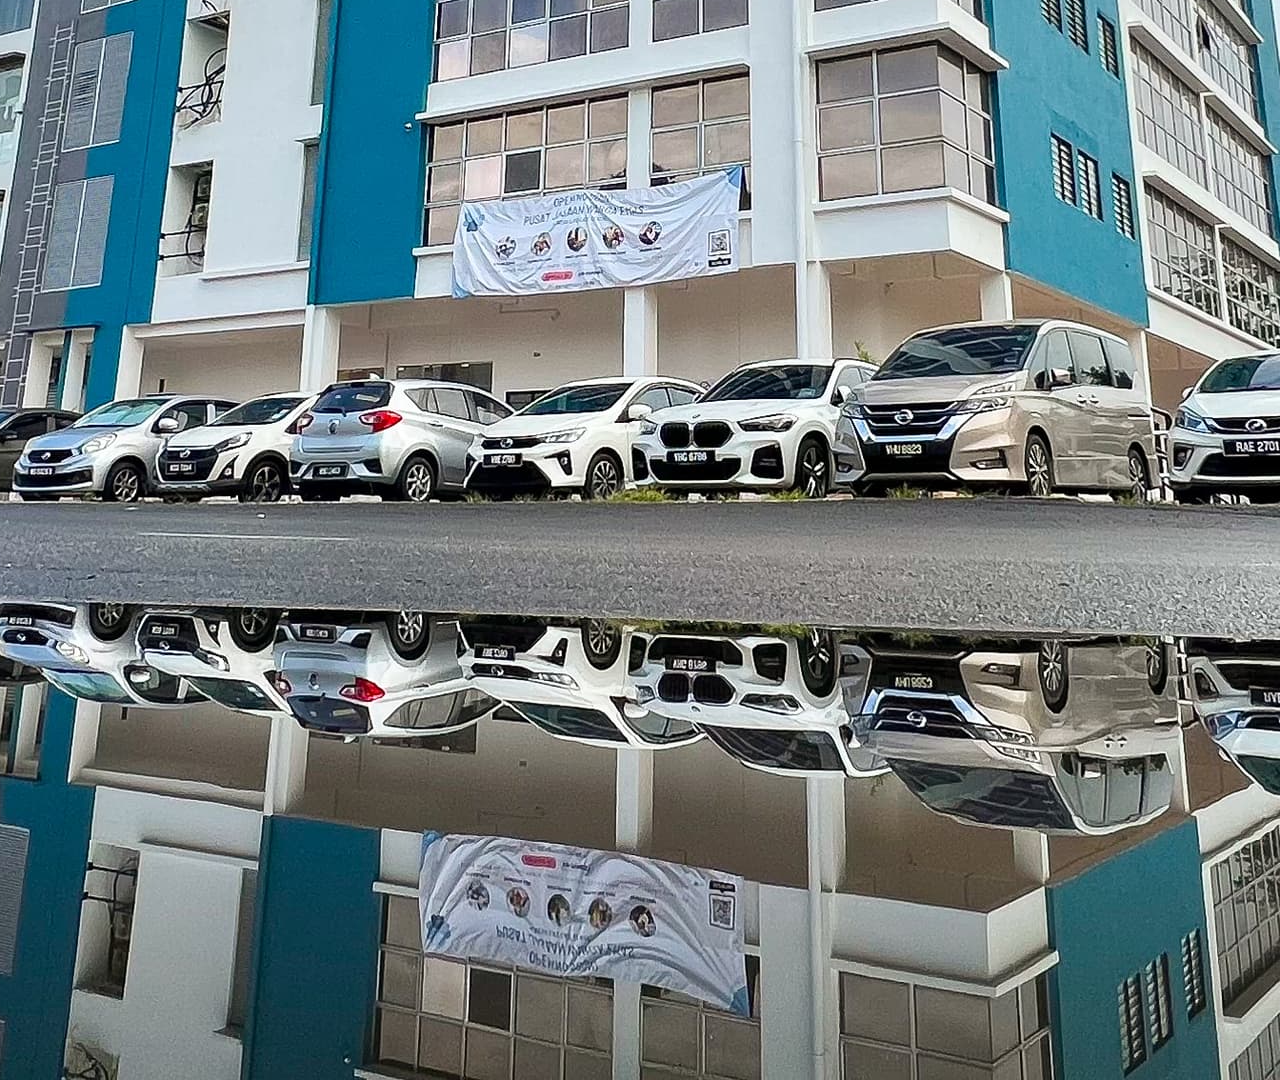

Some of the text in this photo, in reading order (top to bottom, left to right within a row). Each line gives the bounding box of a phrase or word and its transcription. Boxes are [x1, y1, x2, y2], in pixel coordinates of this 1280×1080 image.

[523, 213, 551, 227] PUSAT
[1235, 440, 1280, 452] RAE 2701
